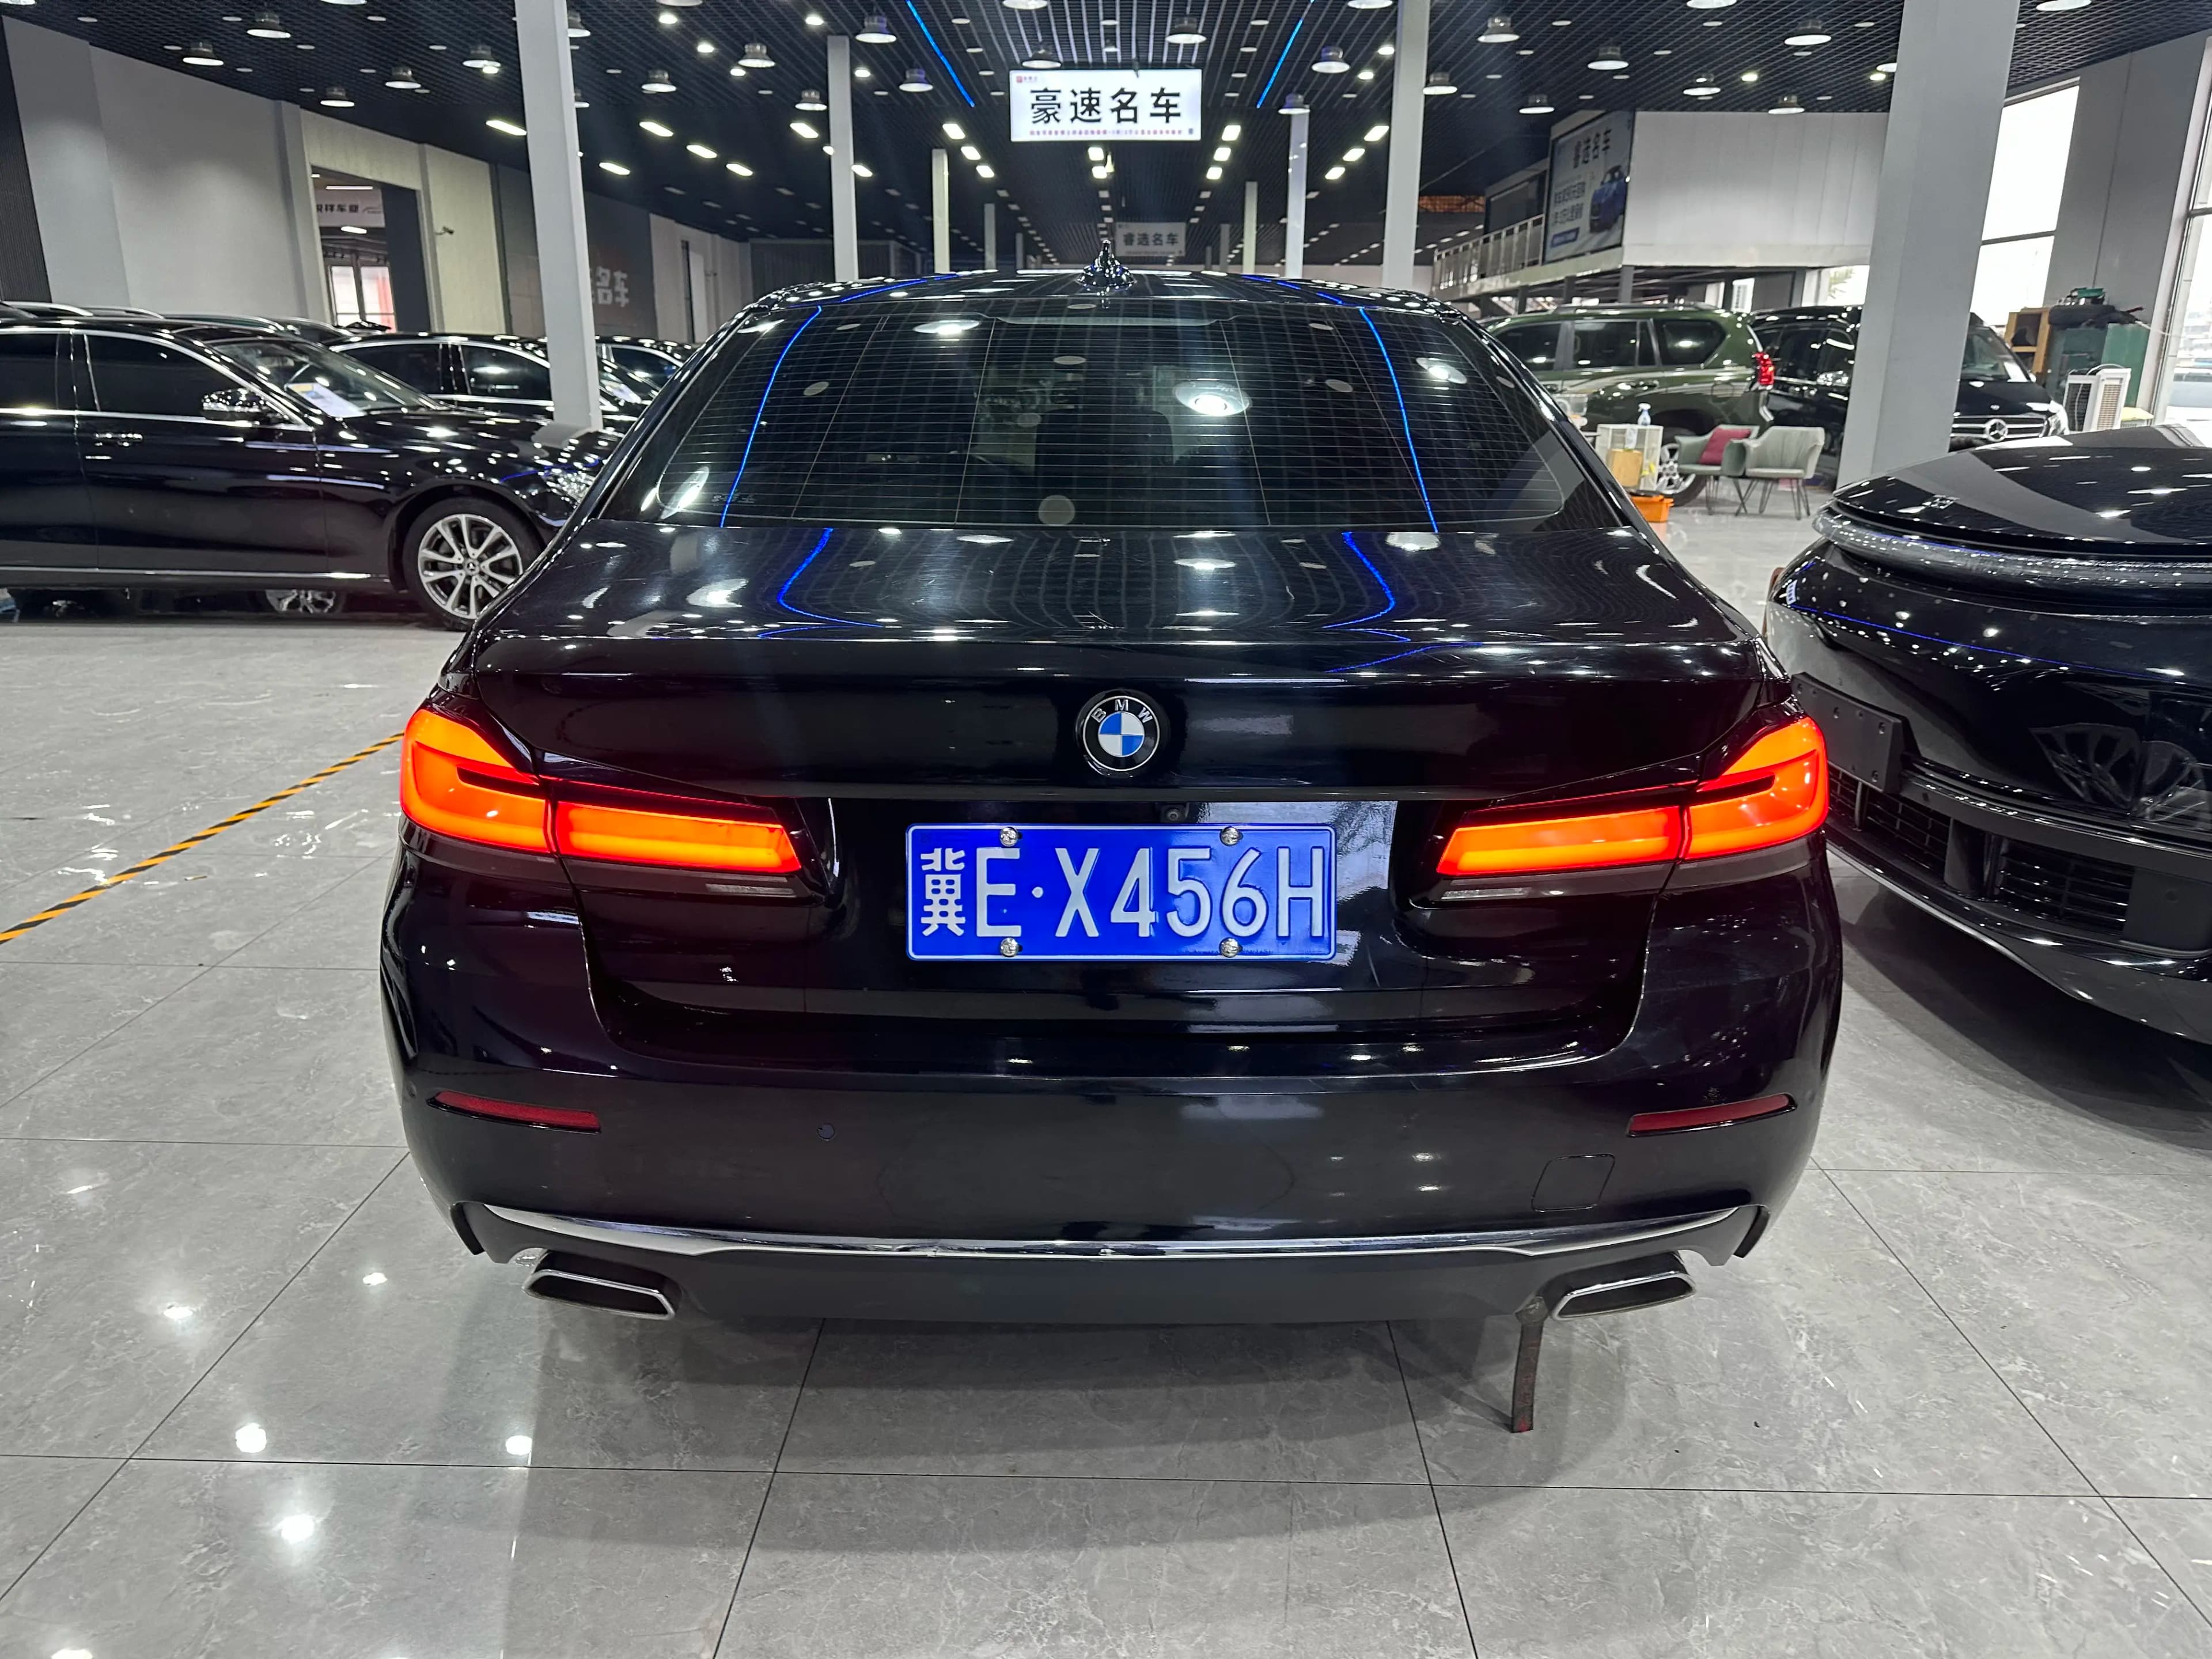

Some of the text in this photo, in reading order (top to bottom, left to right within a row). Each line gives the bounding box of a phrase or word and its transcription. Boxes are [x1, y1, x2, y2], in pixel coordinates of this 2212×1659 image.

[1030, 87, 1181, 124] 豪速名车
[590, 266, 629, 308] 名车
[1091, 699, 1153, 723] BMW
[921, 847, 1324, 938] 冀E·X456H
